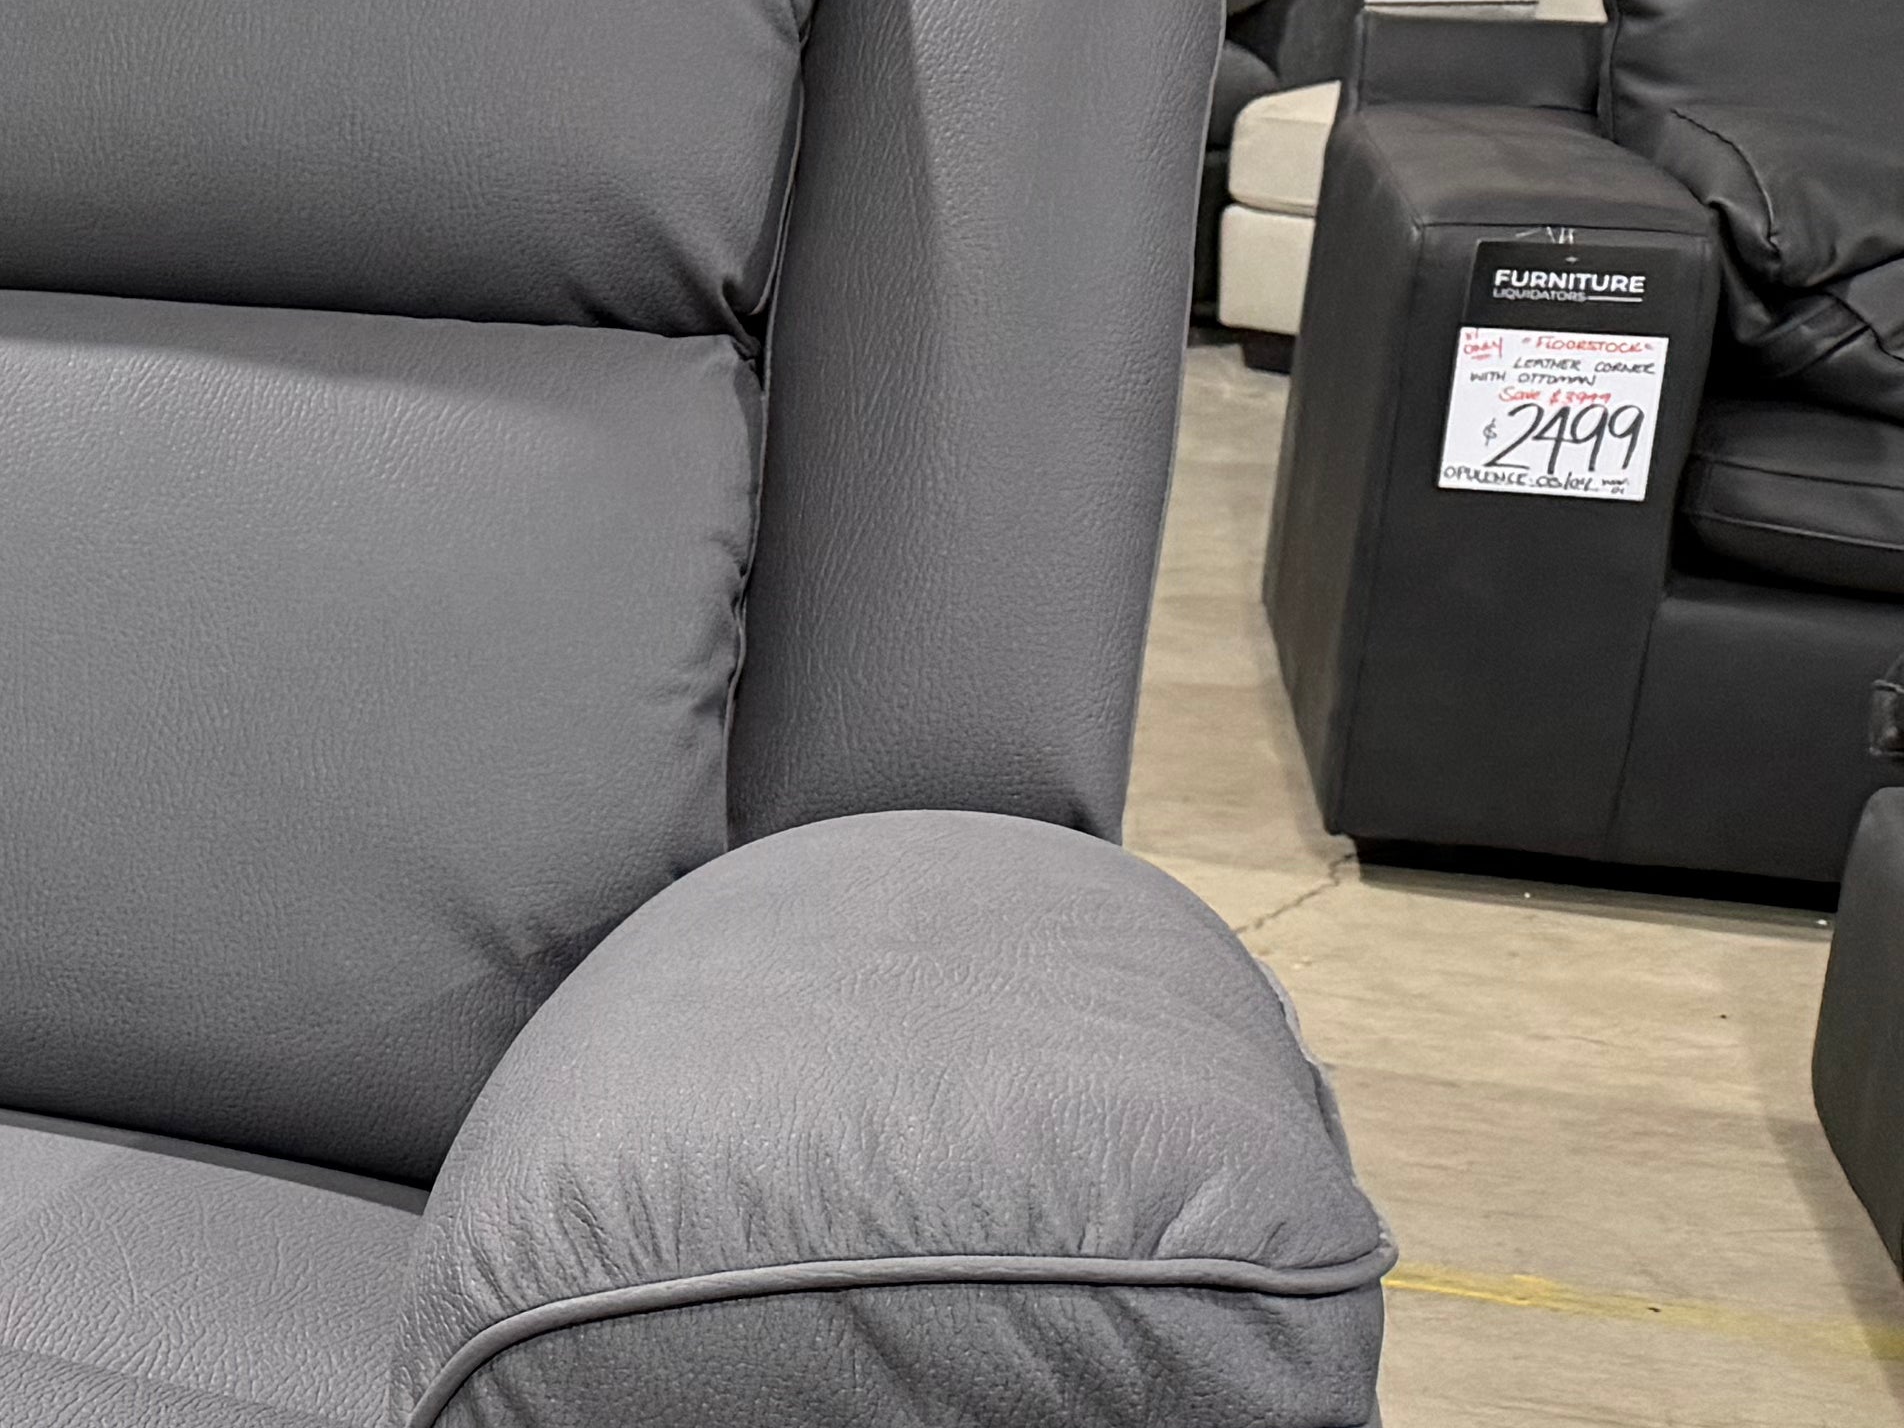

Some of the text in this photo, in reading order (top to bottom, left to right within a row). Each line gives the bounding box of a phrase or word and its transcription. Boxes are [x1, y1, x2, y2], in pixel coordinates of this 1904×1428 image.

[1493, 269, 1646, 294] FURNITURE
[1492, 287, 1587, 303] LIQUIDATORS
[1513, 357, 1656, 374] LEATHER CORNER
[1470, 371, 1596, 387] WITH OTTOMAN
